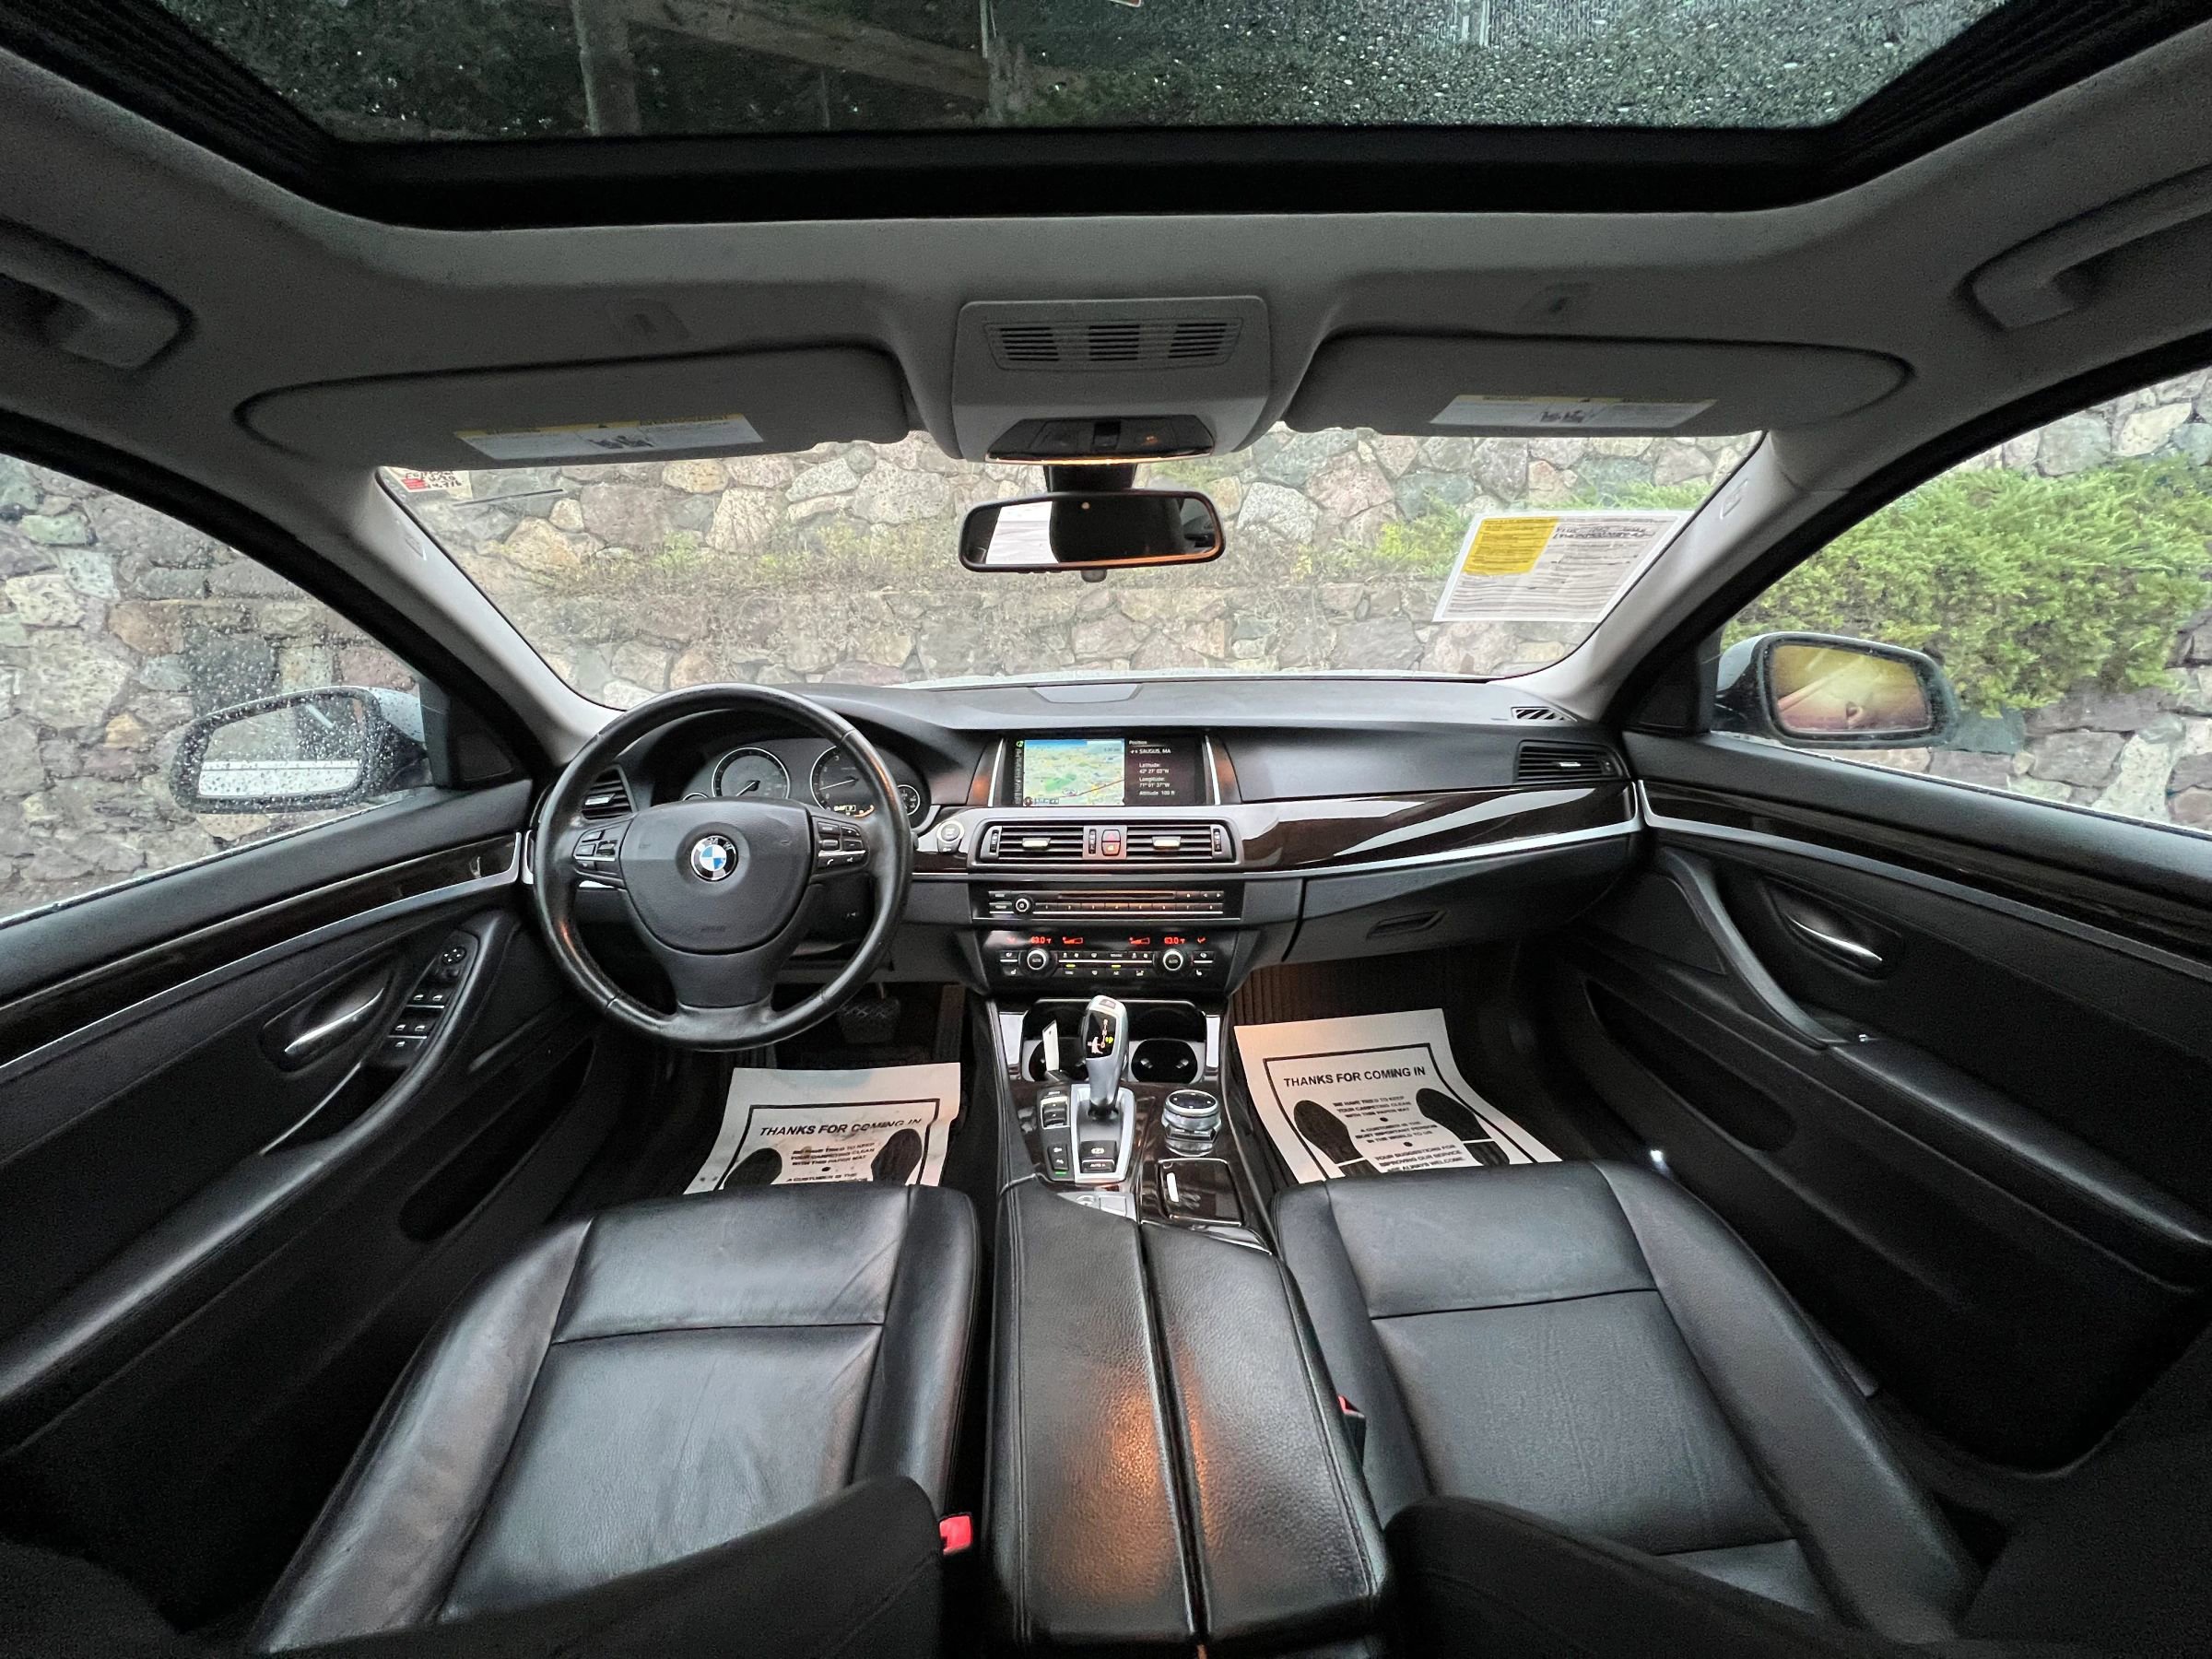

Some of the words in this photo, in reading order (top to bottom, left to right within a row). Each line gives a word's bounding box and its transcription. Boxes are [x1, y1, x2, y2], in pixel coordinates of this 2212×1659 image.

[1284, 1073, 1335, 1088] THANKS
[1336, 1071, 1361, 1084] FOR
[1364, 1067, 1412, 1080] COMING
[1414, 1065, 1427, 1077] IN
[759, 1124, 816, 1136] THANKS
[818, 1124, 847, 1135] FOR
[851, 1120, 905, 1132] COMING
[1432, 1150, 1463, 1159] SERVICE
[1402, 1163, 1430, 1171] ALWAYS
